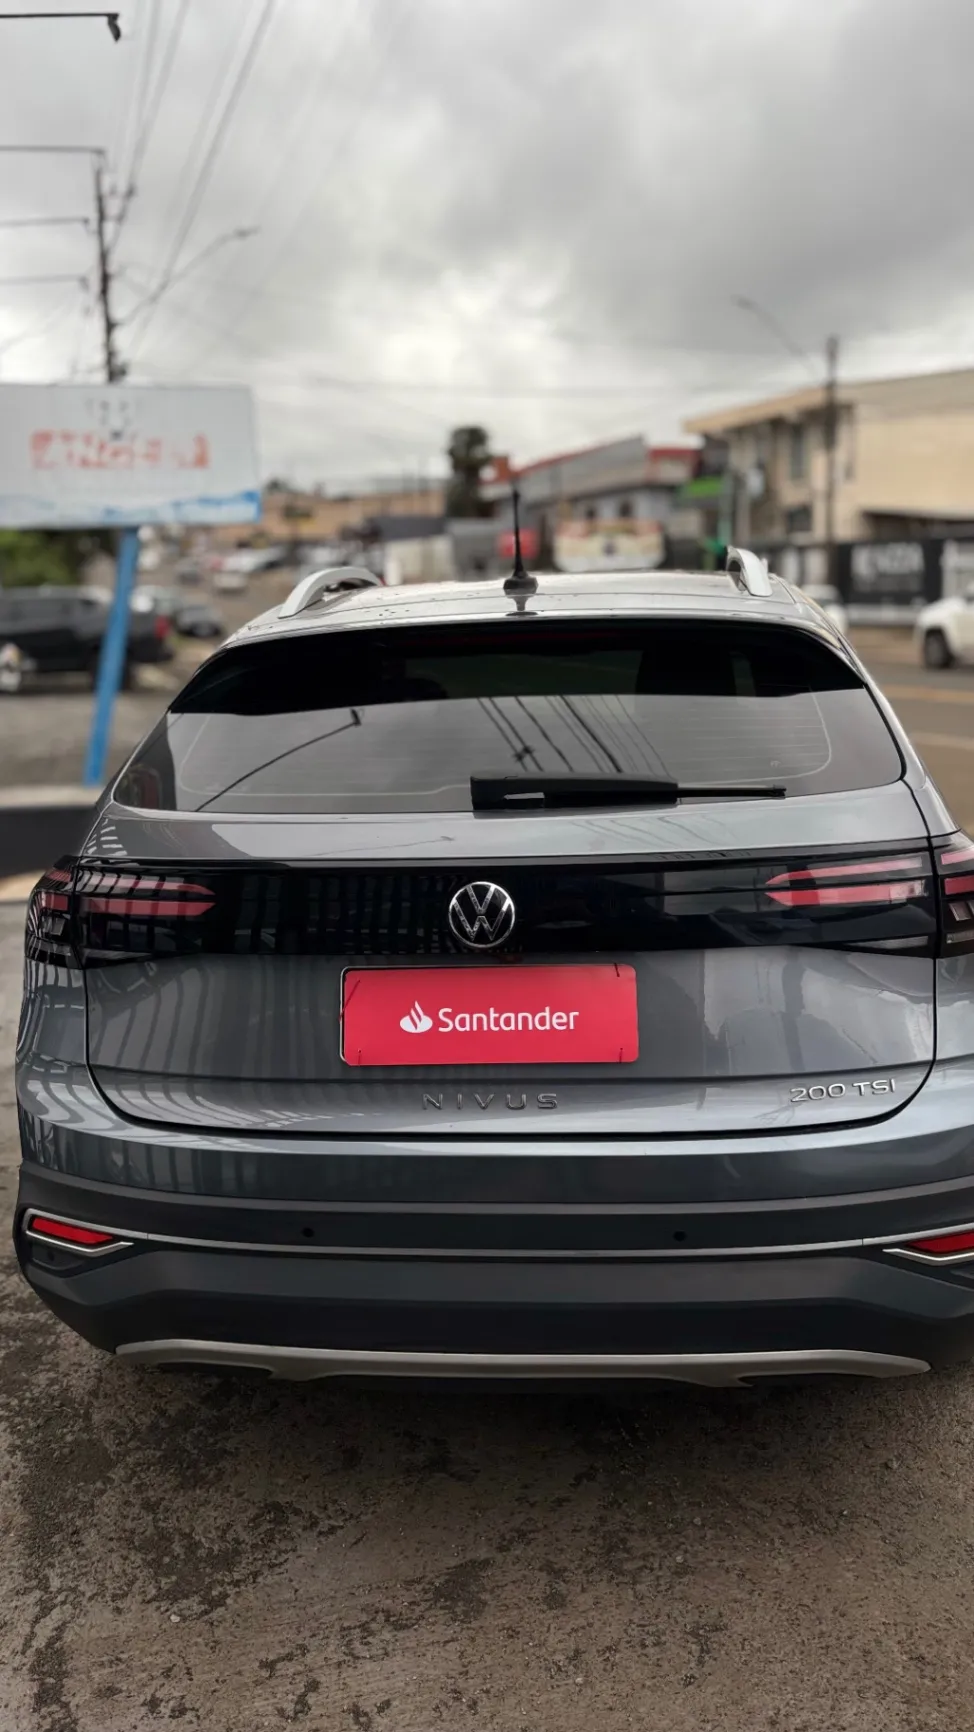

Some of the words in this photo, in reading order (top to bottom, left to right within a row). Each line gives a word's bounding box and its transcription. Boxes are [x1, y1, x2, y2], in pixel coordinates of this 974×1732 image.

[438, 1007, 580, 1032] Santander
[423, 1092, 559, 1111] NIVUS
[790, 1084, 846, 1102] 200
[852, 1078, 896, 1096] TSI
